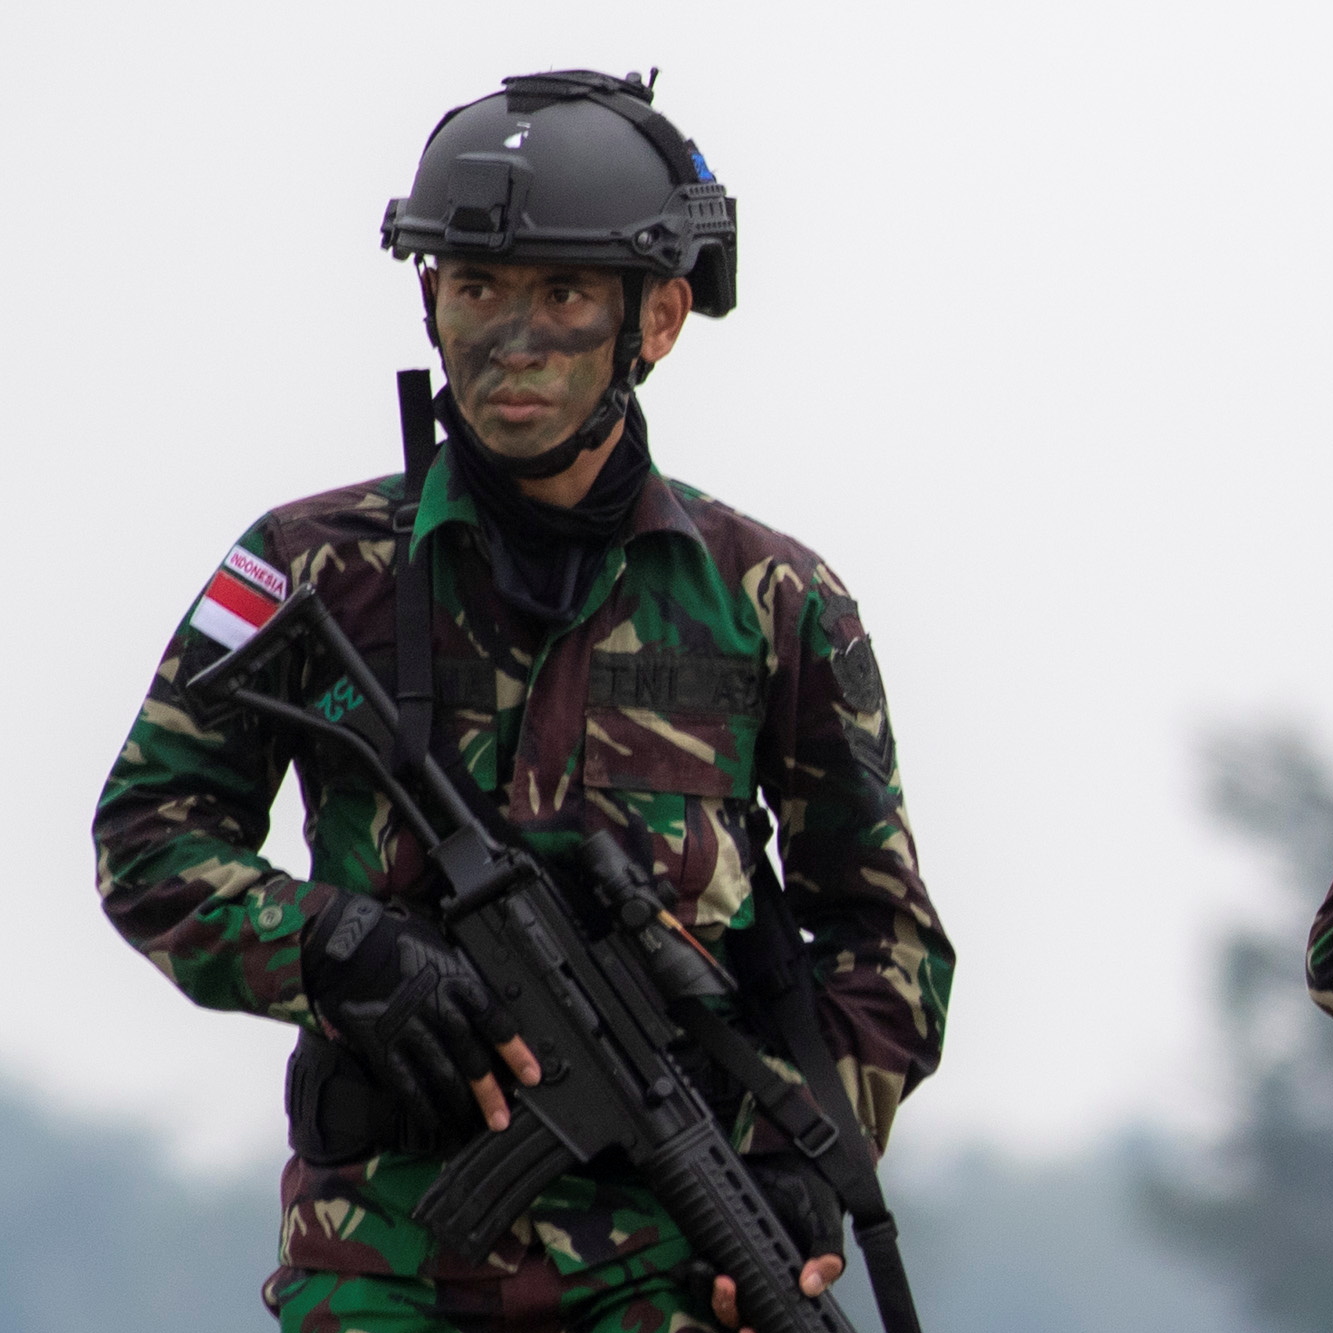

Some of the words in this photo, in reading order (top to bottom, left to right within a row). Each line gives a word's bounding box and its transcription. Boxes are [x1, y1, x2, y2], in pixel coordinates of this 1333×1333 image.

[229, 551, 285, 595] INDONESIA
[314, 675, 365, 723] 32
[605, 664, 678, 706] TNI
